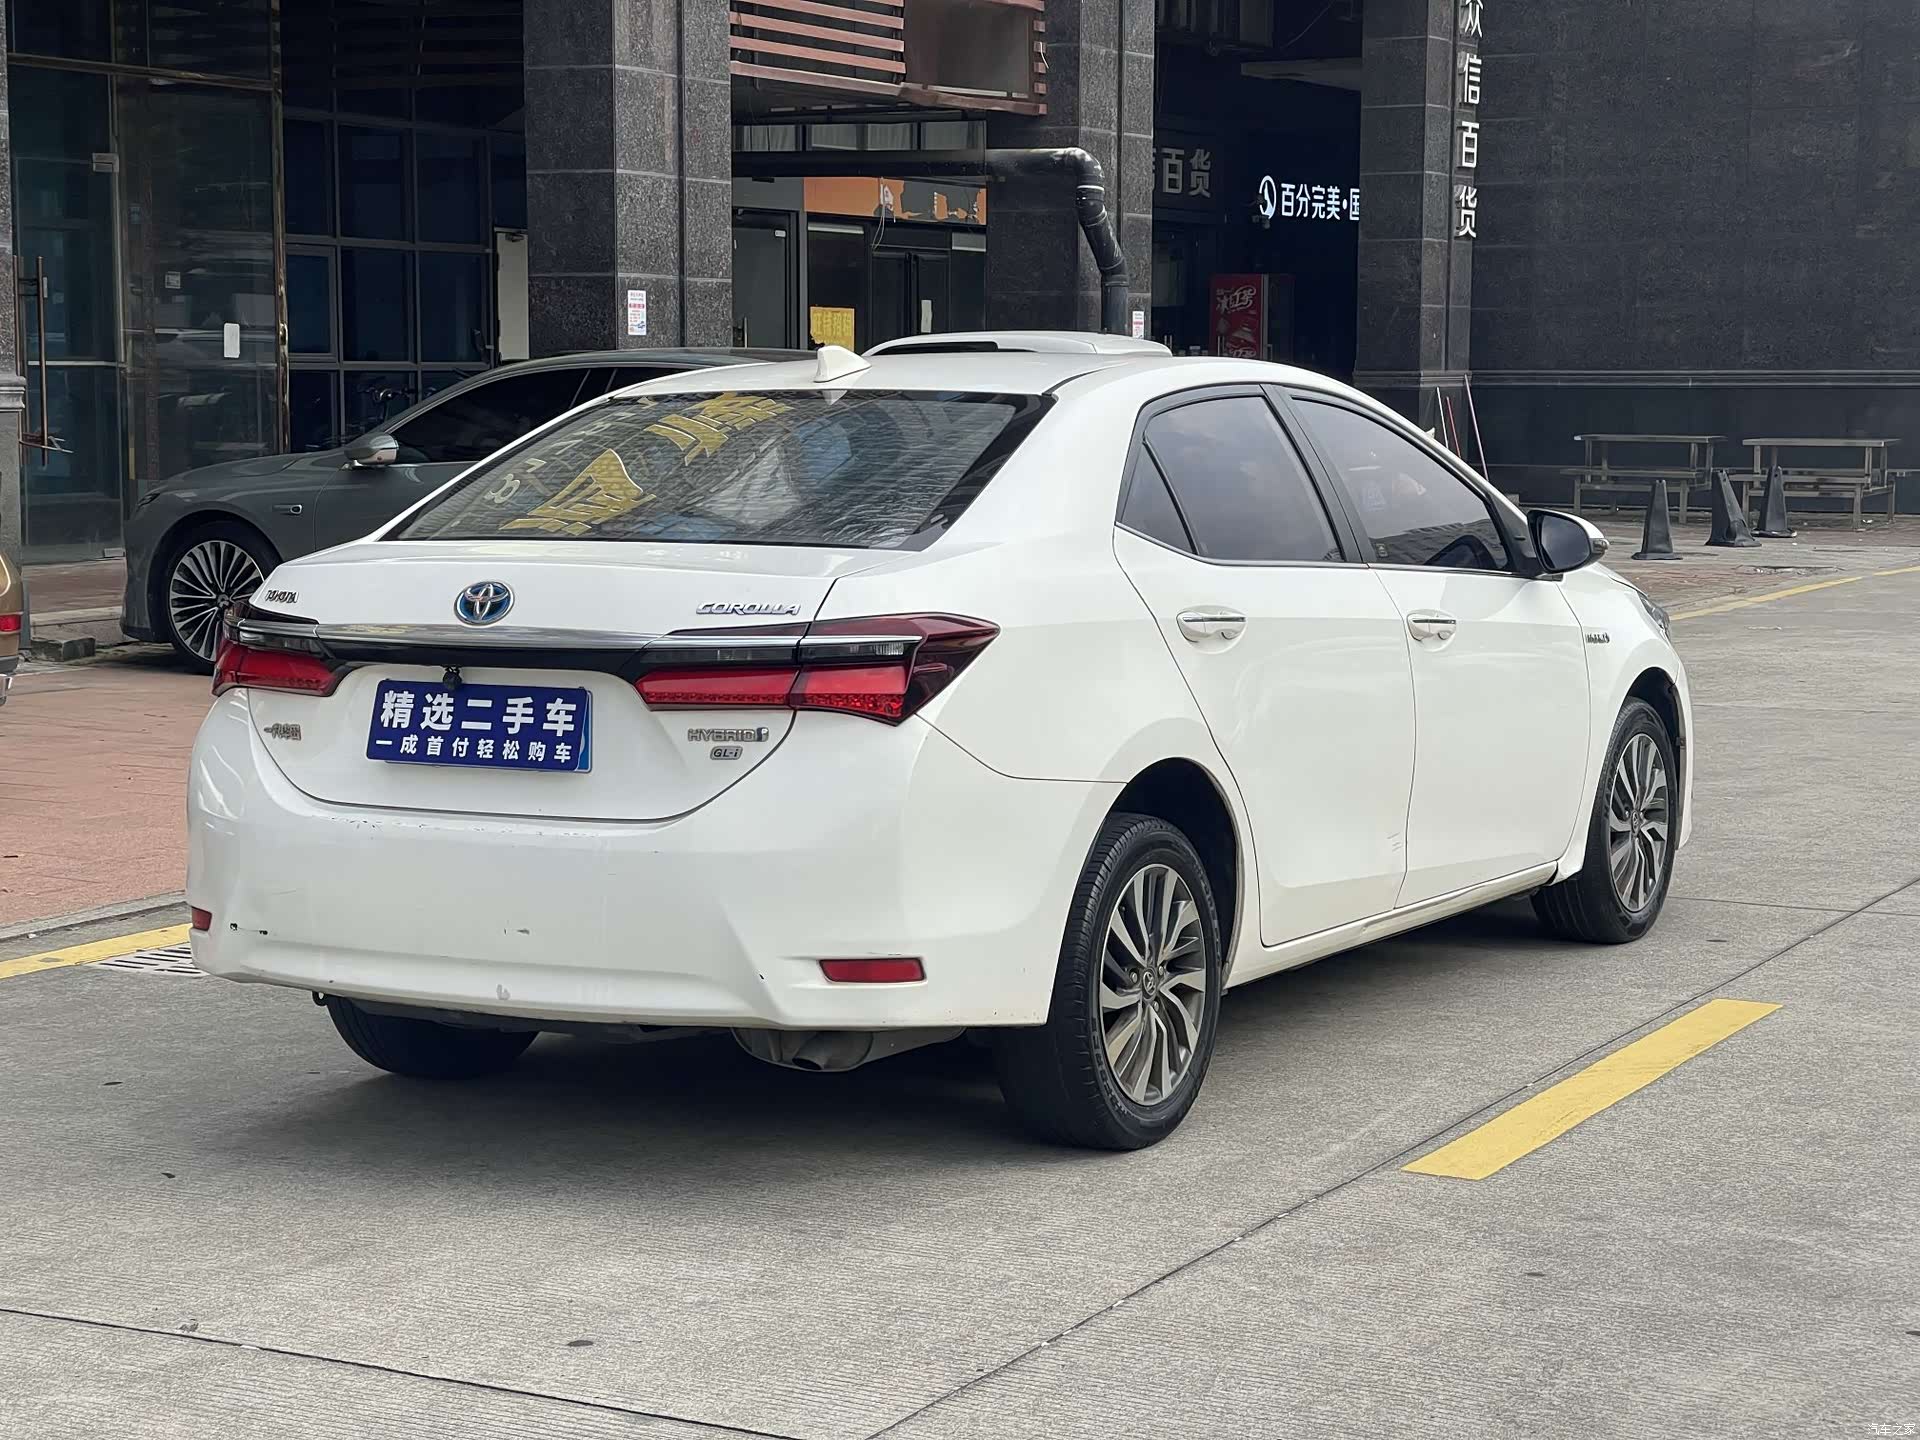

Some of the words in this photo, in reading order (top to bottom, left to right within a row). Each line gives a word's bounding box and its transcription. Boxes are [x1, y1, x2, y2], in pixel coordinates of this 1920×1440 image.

[1152, 147, 1212, 198] 百货
[696, 602, 801, 616] COROLLA
[380, 690, 577, 737] 精选二手车
[687, 728, 756, 742] HYBRID
[375, 734, 573, 763] 一成首付轻松购车
[713, 748, 739, 758] GL-i
